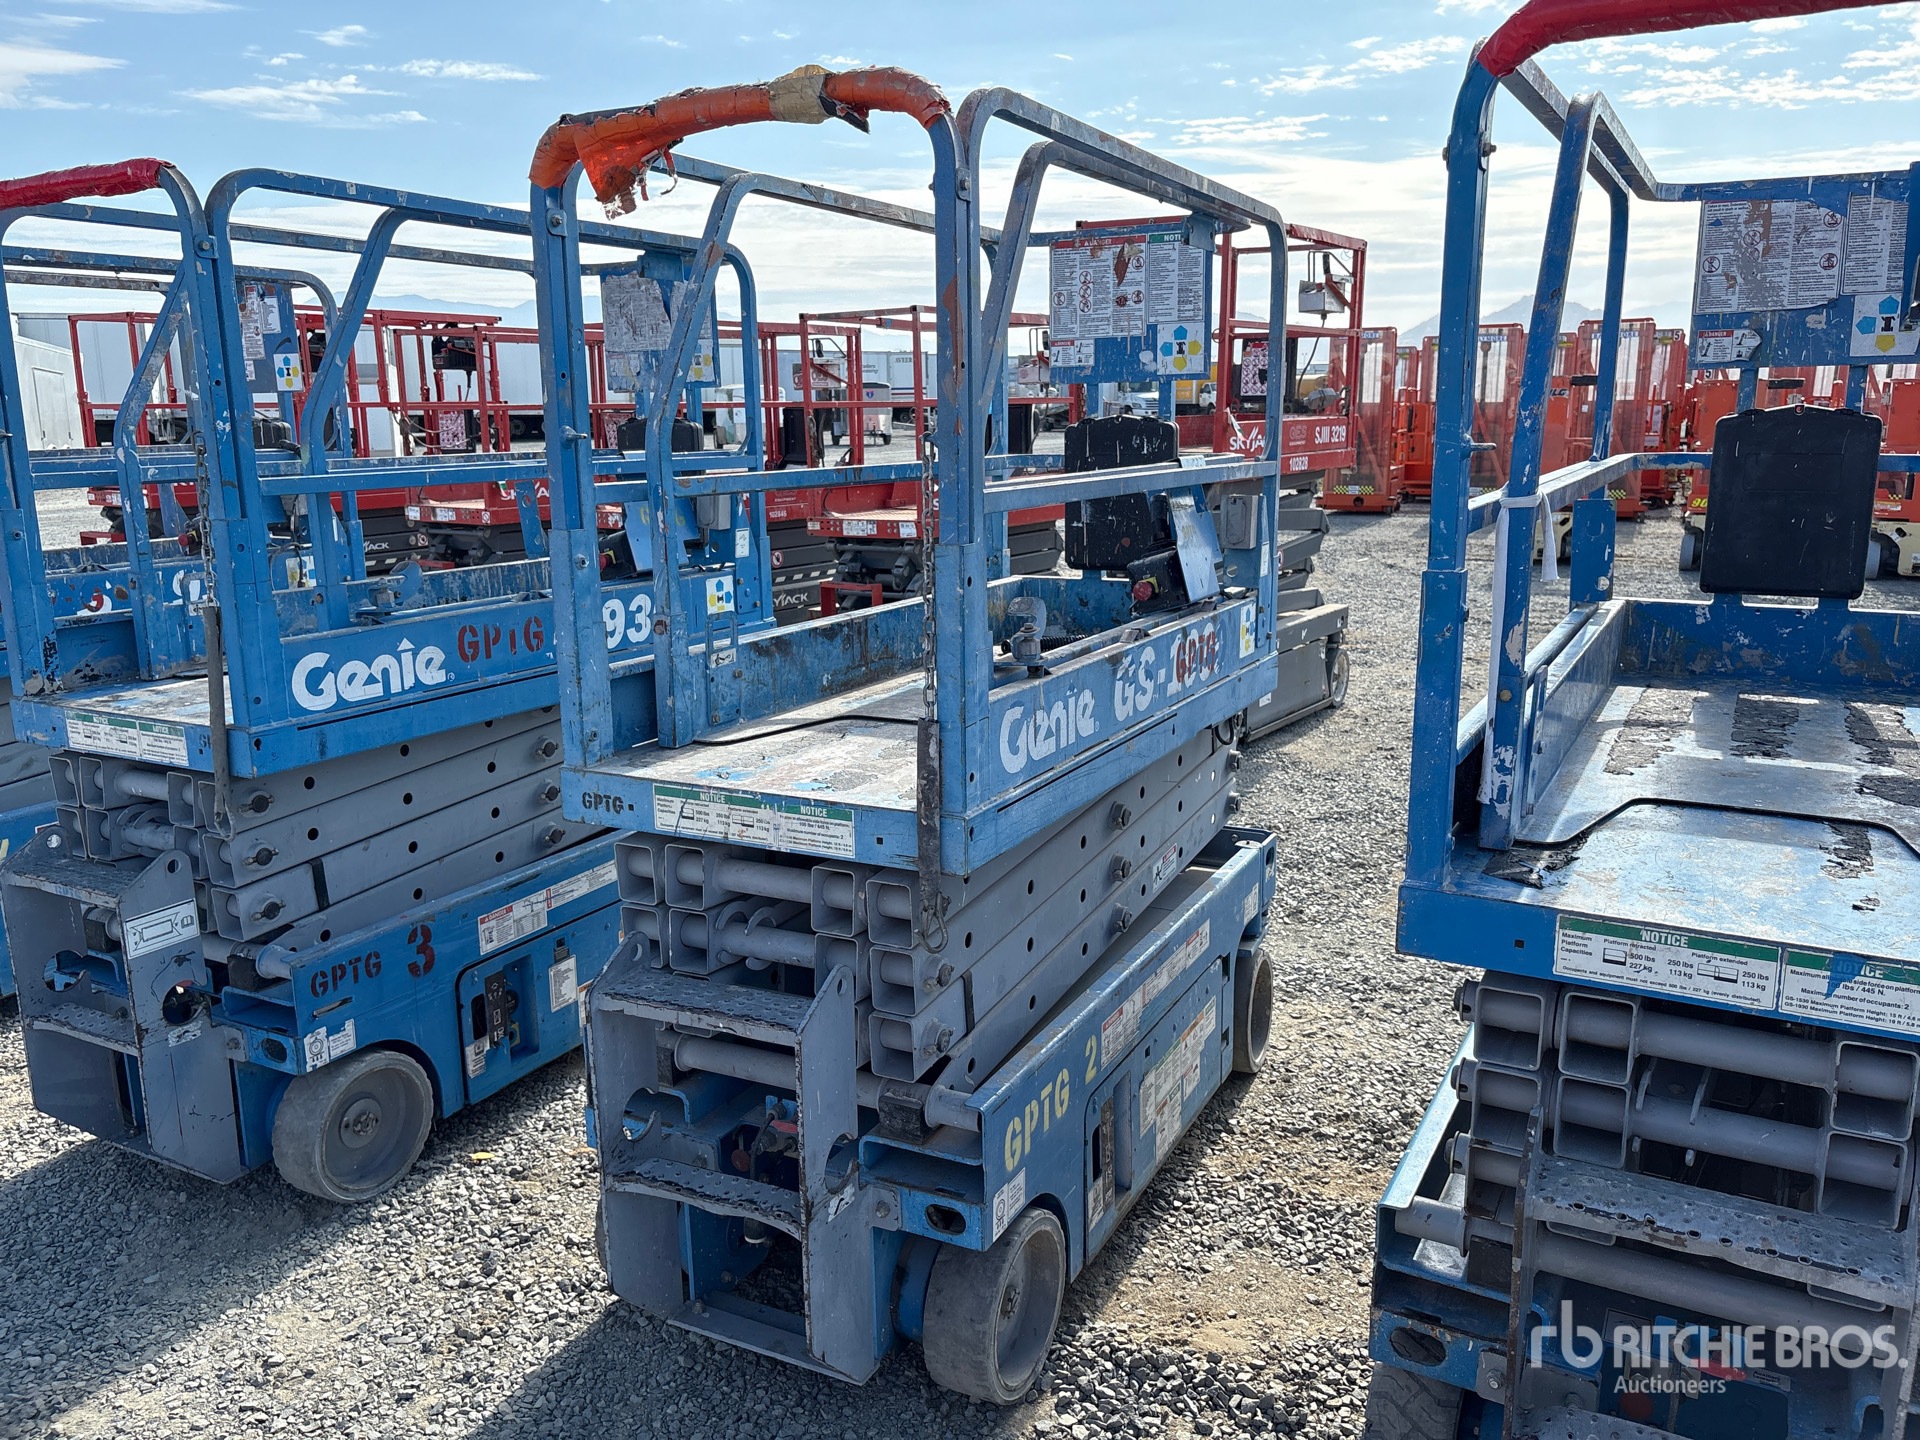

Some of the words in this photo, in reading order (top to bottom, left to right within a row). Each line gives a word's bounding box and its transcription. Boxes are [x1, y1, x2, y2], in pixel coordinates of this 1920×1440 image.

[1163, 233, 1181, 242] NOTI
[1674, 331, 1681, 341] 5
[1229, 427, 1266, 453] SKYJA
[1331, 425, 1347, 443] 3219
[291, 637, 447, 711] Genie
[1000, 679, 1096, 774] Genie
[582, 791, 624, 815] GPTG
[700, 791, 725, 803] NOTICE
[800, 805, 828, 818] NOTICE
[1561, 939, 1589, 949] Platform
[1562, 932, 1593, 942] Maximum
[1641, 929, 1689, 948] NOTICE
[1560, 946, 1593, 957] Capacities
[1603, 938, 1629, 947] Platform
[1629, 942, 1657, 951] retracted
[311, 951, 382, 998] GPTG
[407, 924, 436, 978] 3
[1629, 952, 1643, 961] 500
[1644, 954, 1656, 963] lbs
[1667, 958, 1681, 967] 250
[1681, 960, 1694, 969] lbs
[1691, 951, 1718, 961] Platform
[1718, 956, 1748, 966] extended
[1629, 962, 1642, 970] 227
[1643, 963, 1653, 973] kg
[1669, 968, 1682, 977] 113
[1683, 971, 1693, 980] kg
[1562, 965, 1587, 975] Occupants
[1599, 971, 1625, 981] equipment
[1711, 990, 1730, 999] (evenly
[1742, 970, 1757, 979] 250
[1757, 972, 1770, 981] lbs
[1789, 968, 1822, 979] Maximum
[1853, 978, 1868, 987] side
[1868, 981, 1885, 989] force
[1741, 980, 1755, 989] 113
[1755, 982, 1766, 991] kg
[1842, 983, 1855, 992] lbs
[1861, 986, 1876, 995] 445
[1877, 989, 1886, 997] N.
[1785, 995, 1810, 1004] GS-1530
[1810, 999, 1839, 1009] Maximum
[1840, 1004, 1865, 1013] Platform
[1866, 1008, 1888, 1017] Height:
[1800, 987, 1828, 998] Maximu
[1833, 993, 1859, 1003] number
[1866, 998, 1904, 1011] occupants:
[1904, 1003, 1910, 1011] 2
[1809, 1005, 1838, 1015] Maximum
[1839, 1010, 1865, 1019] Platform
[1865, 1014, 1887, 1023] Height:
[1004, 1068, 1070, 1172] GPTG
[1085, 1034, 1097, 1086] 2
